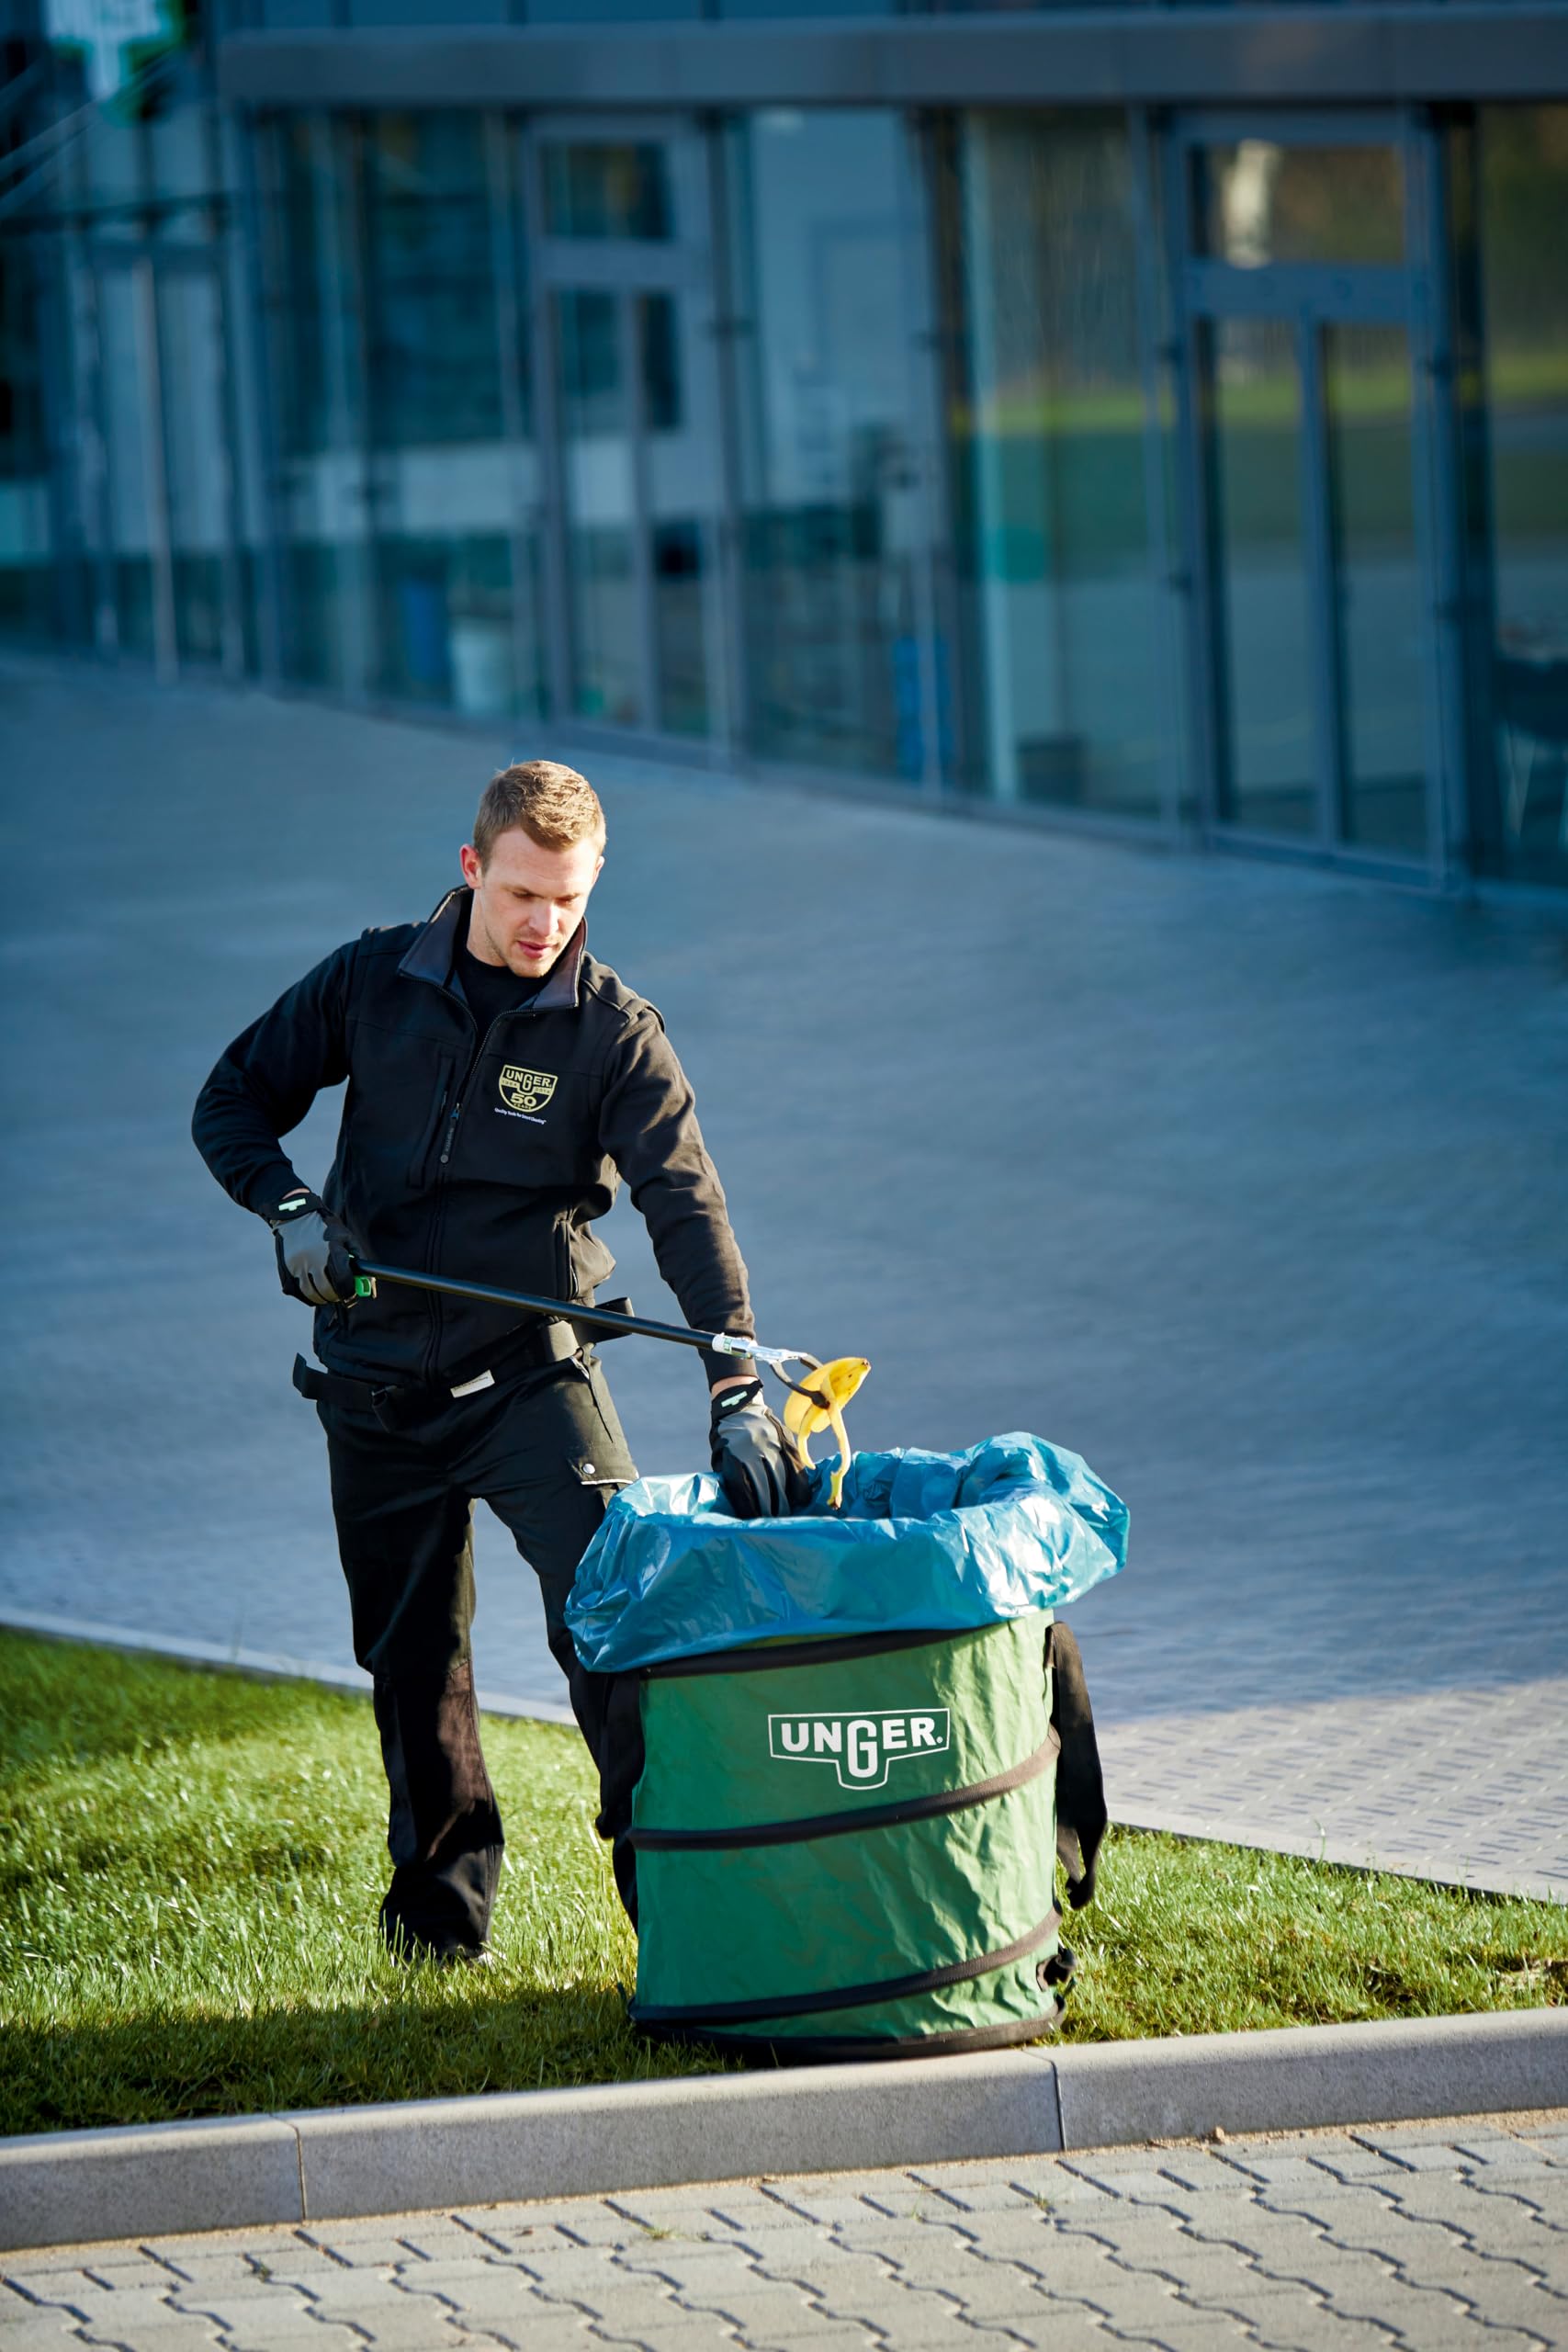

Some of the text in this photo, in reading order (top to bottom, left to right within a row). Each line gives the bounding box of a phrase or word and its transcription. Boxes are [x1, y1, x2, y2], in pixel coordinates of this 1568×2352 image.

[506, 1069, 550, 1091] UNGER
[510, 1092, 536, 1107] 50
[781, 1717, 937, 1778] UNGER
